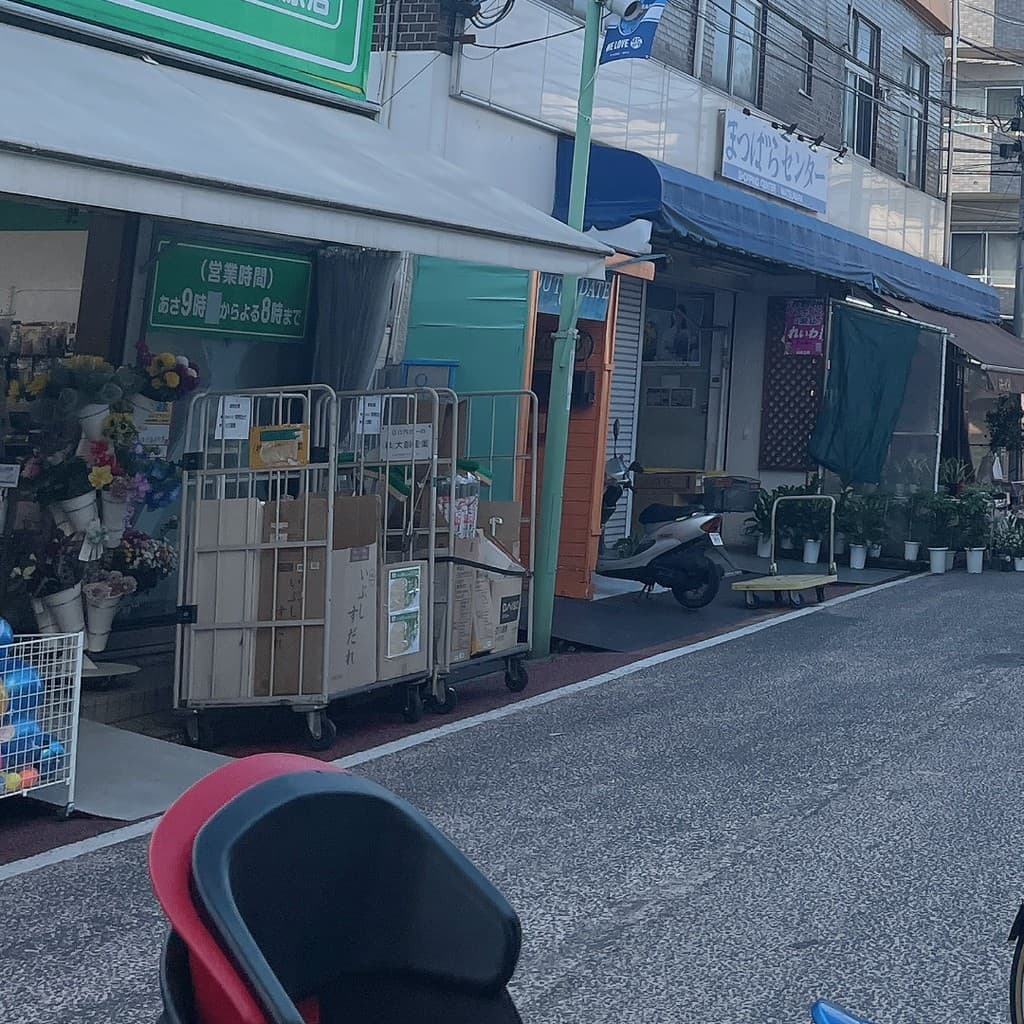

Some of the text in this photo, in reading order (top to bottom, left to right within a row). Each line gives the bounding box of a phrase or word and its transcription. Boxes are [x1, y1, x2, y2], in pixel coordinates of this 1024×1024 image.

[725, 120, 826, 189] まつばらセンター
[201, 259, 273, 290] (営業時間)
[578, 278, 612, 299] DATE
[345, 605, 360, 666] すだれ
